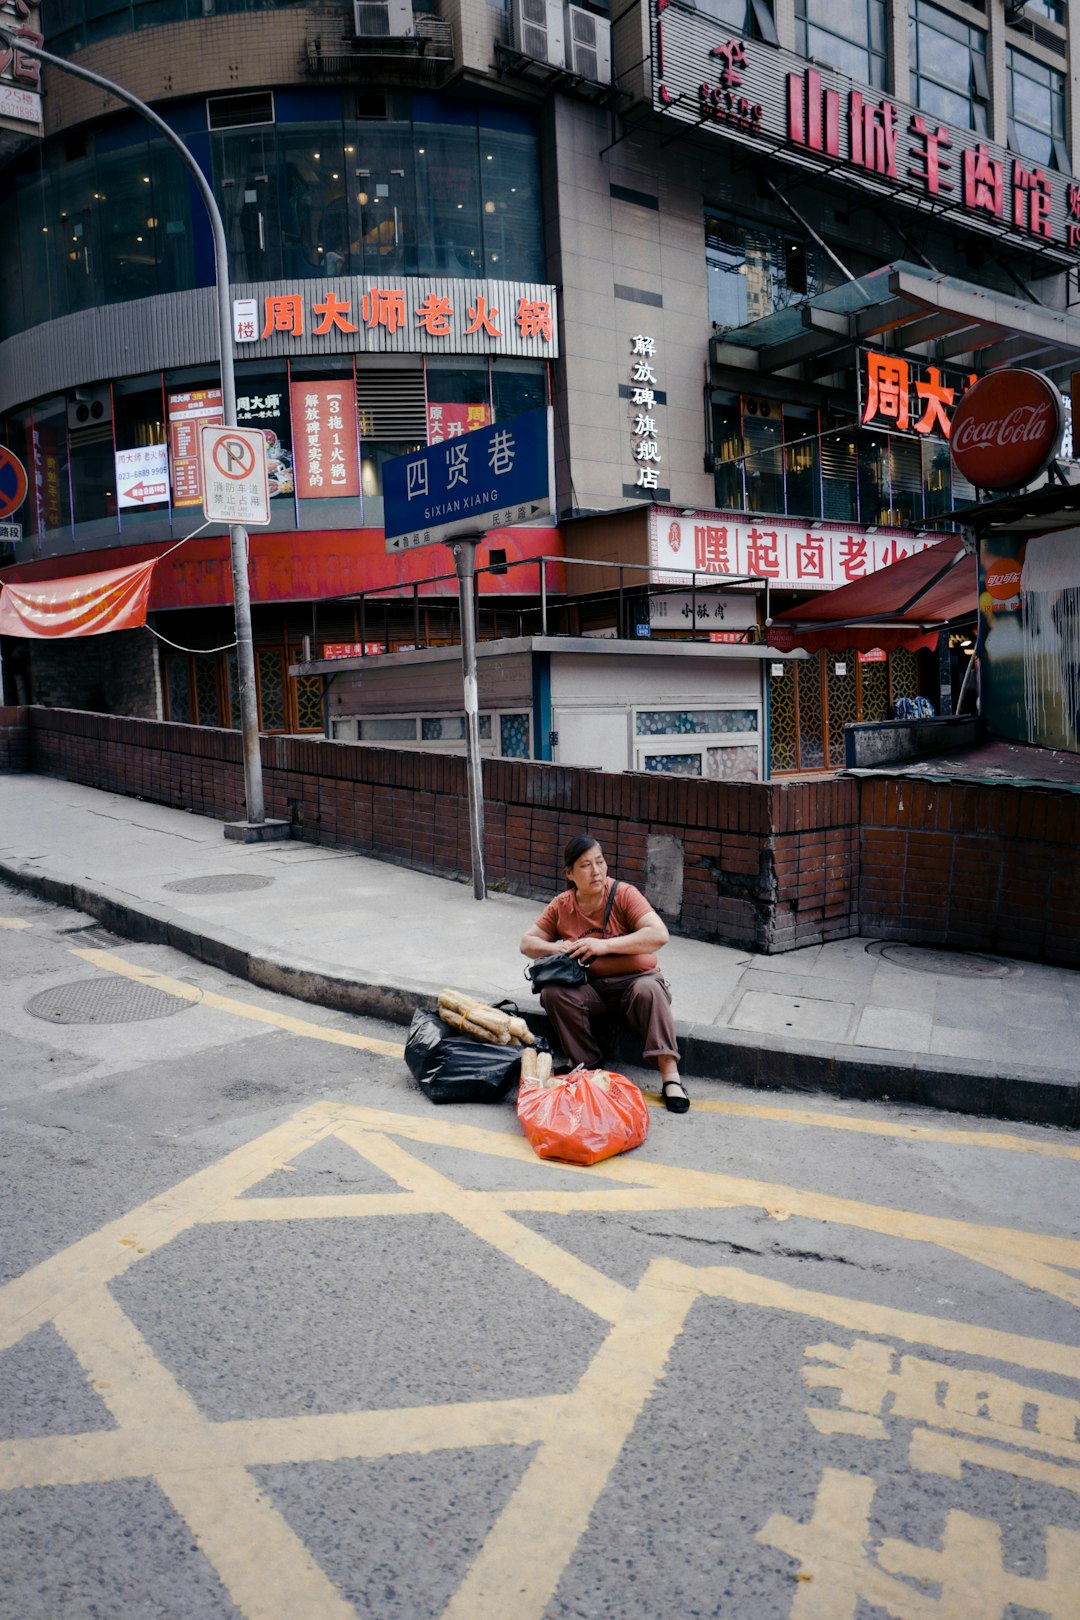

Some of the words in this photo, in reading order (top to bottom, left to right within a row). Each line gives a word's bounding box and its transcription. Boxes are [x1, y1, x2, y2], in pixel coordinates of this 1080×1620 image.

[700, 81, 764, 119] SCYRG
[785, 68, 1052, 240] 山城羊肉馆
[237, 301, 256, 339] 二楼
[260, 287, 554, 342] 周大师老火锅
[237, 393, 280, 411] 周大师
[630, 334, 662, 490] 解放碑旗舰店
[862, 350, 978, 439] 周大
[304, 393, 324, 487] 解放碑更实惠的
[952, 402, 1052, 453] Coca-Cola
[406, 429, 516, 502] 四贤巷
[213, 481, 259, 495] 消防车道
[213, 494, 260, 507] 禁止占用
[424, 499, 460, 519] SIXIAN
[463, 488, 499, 509] XIANG
[492, 506, 527, 526] 民生路
[693, 524, 936, 582] 嘿起卤老火
[681, 602, 726, 620] 小酥肉
